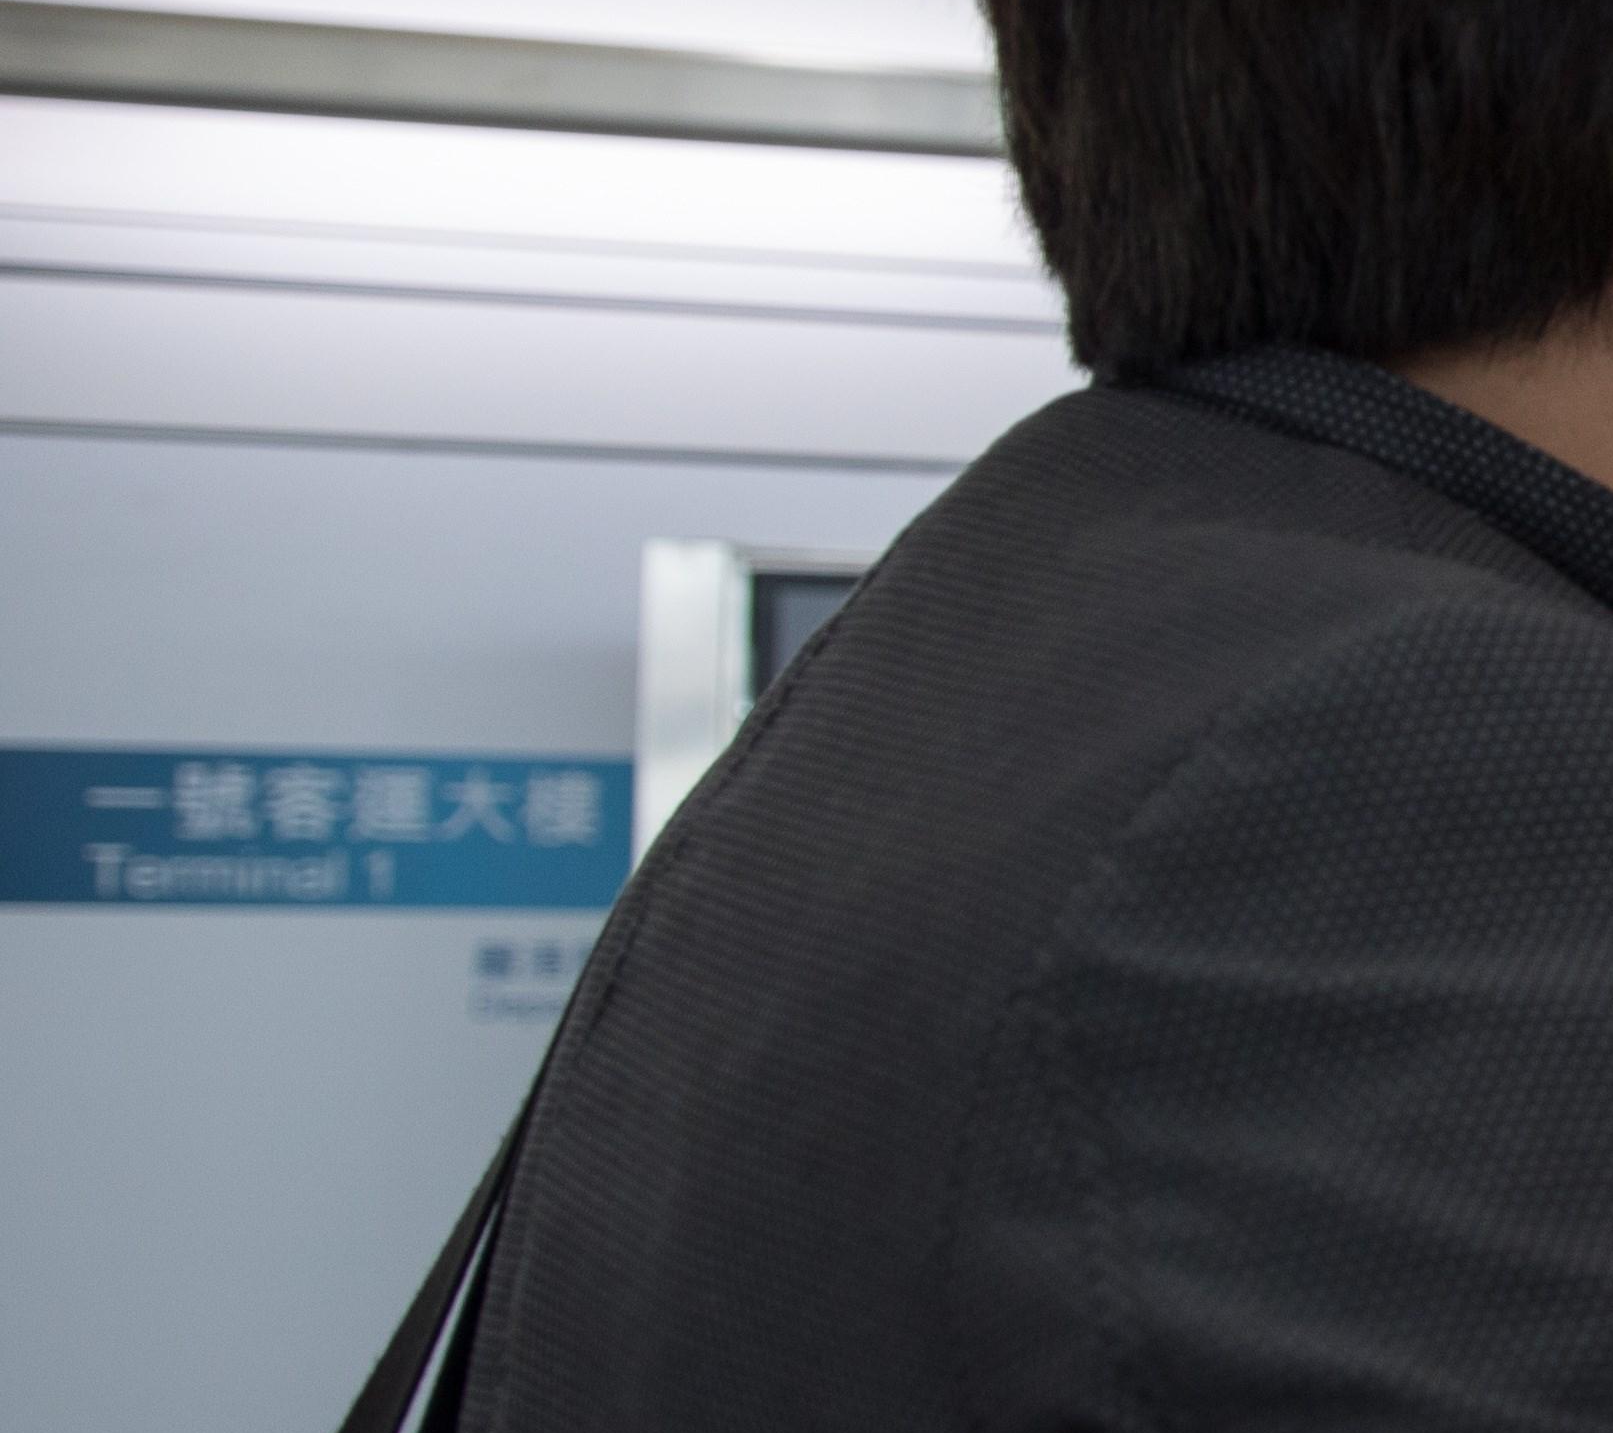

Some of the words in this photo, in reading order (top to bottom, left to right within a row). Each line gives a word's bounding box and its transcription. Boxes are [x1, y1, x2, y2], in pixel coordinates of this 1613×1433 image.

[84, 762, 604, 846] 一號客運大樓
[84, 844, 348, 898] Terminal
[366, 849, 397, 898] 1
